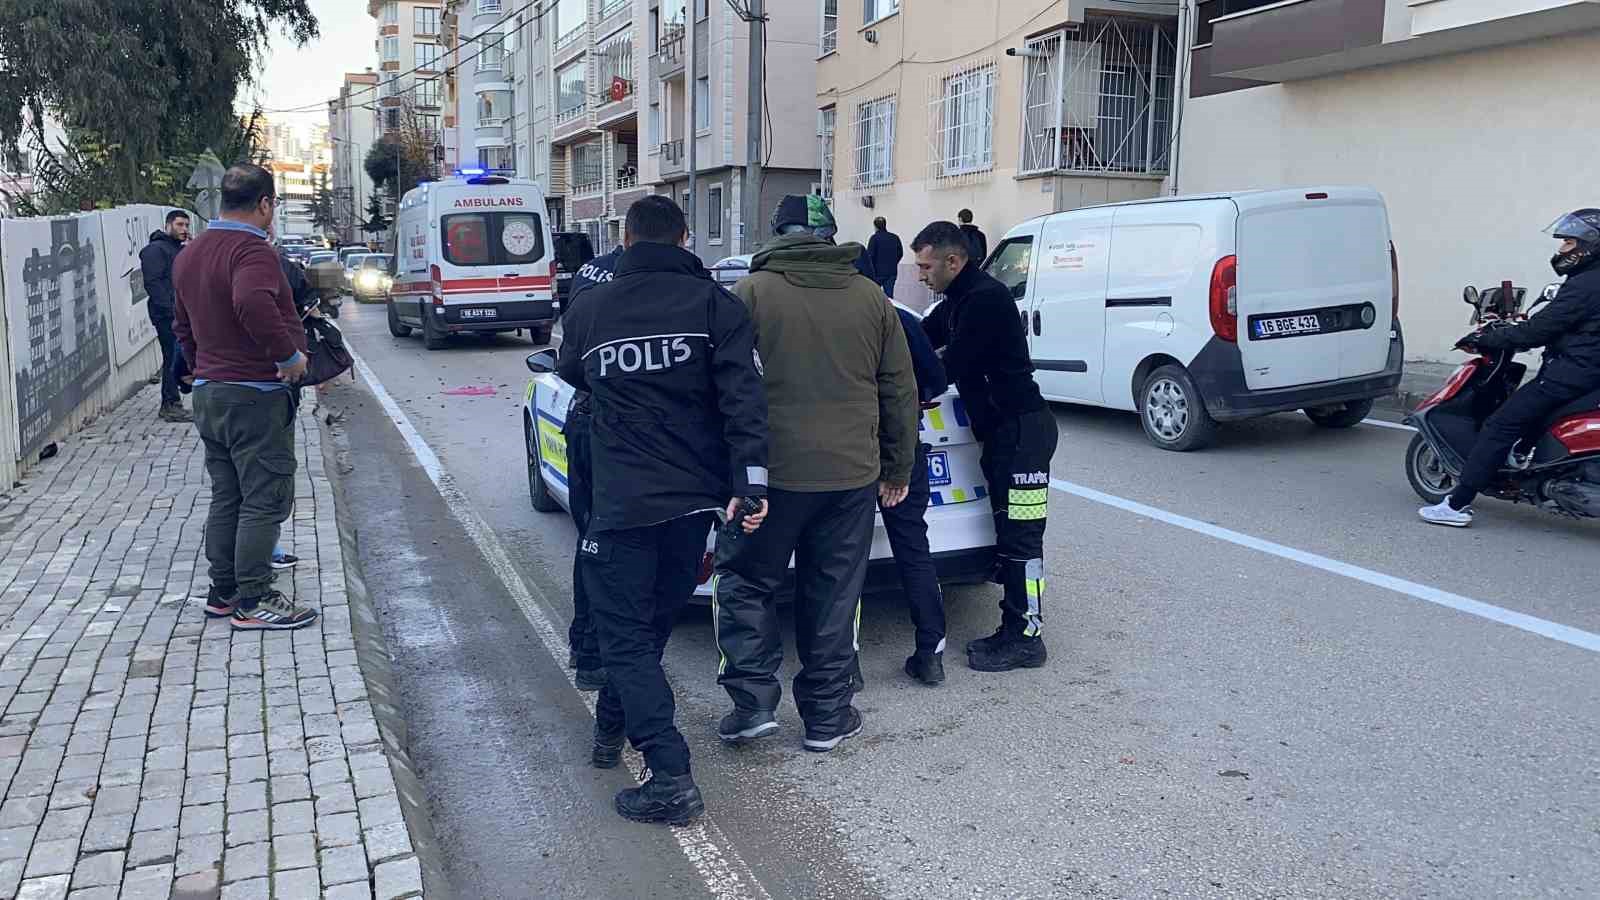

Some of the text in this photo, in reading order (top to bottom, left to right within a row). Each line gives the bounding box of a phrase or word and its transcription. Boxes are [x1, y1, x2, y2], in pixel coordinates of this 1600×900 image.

[454, 197, 523, 208] AMBULANS
[1262, 315, 1318, 333] 16 BGE 432
[927, 456, 944, 477] 6
